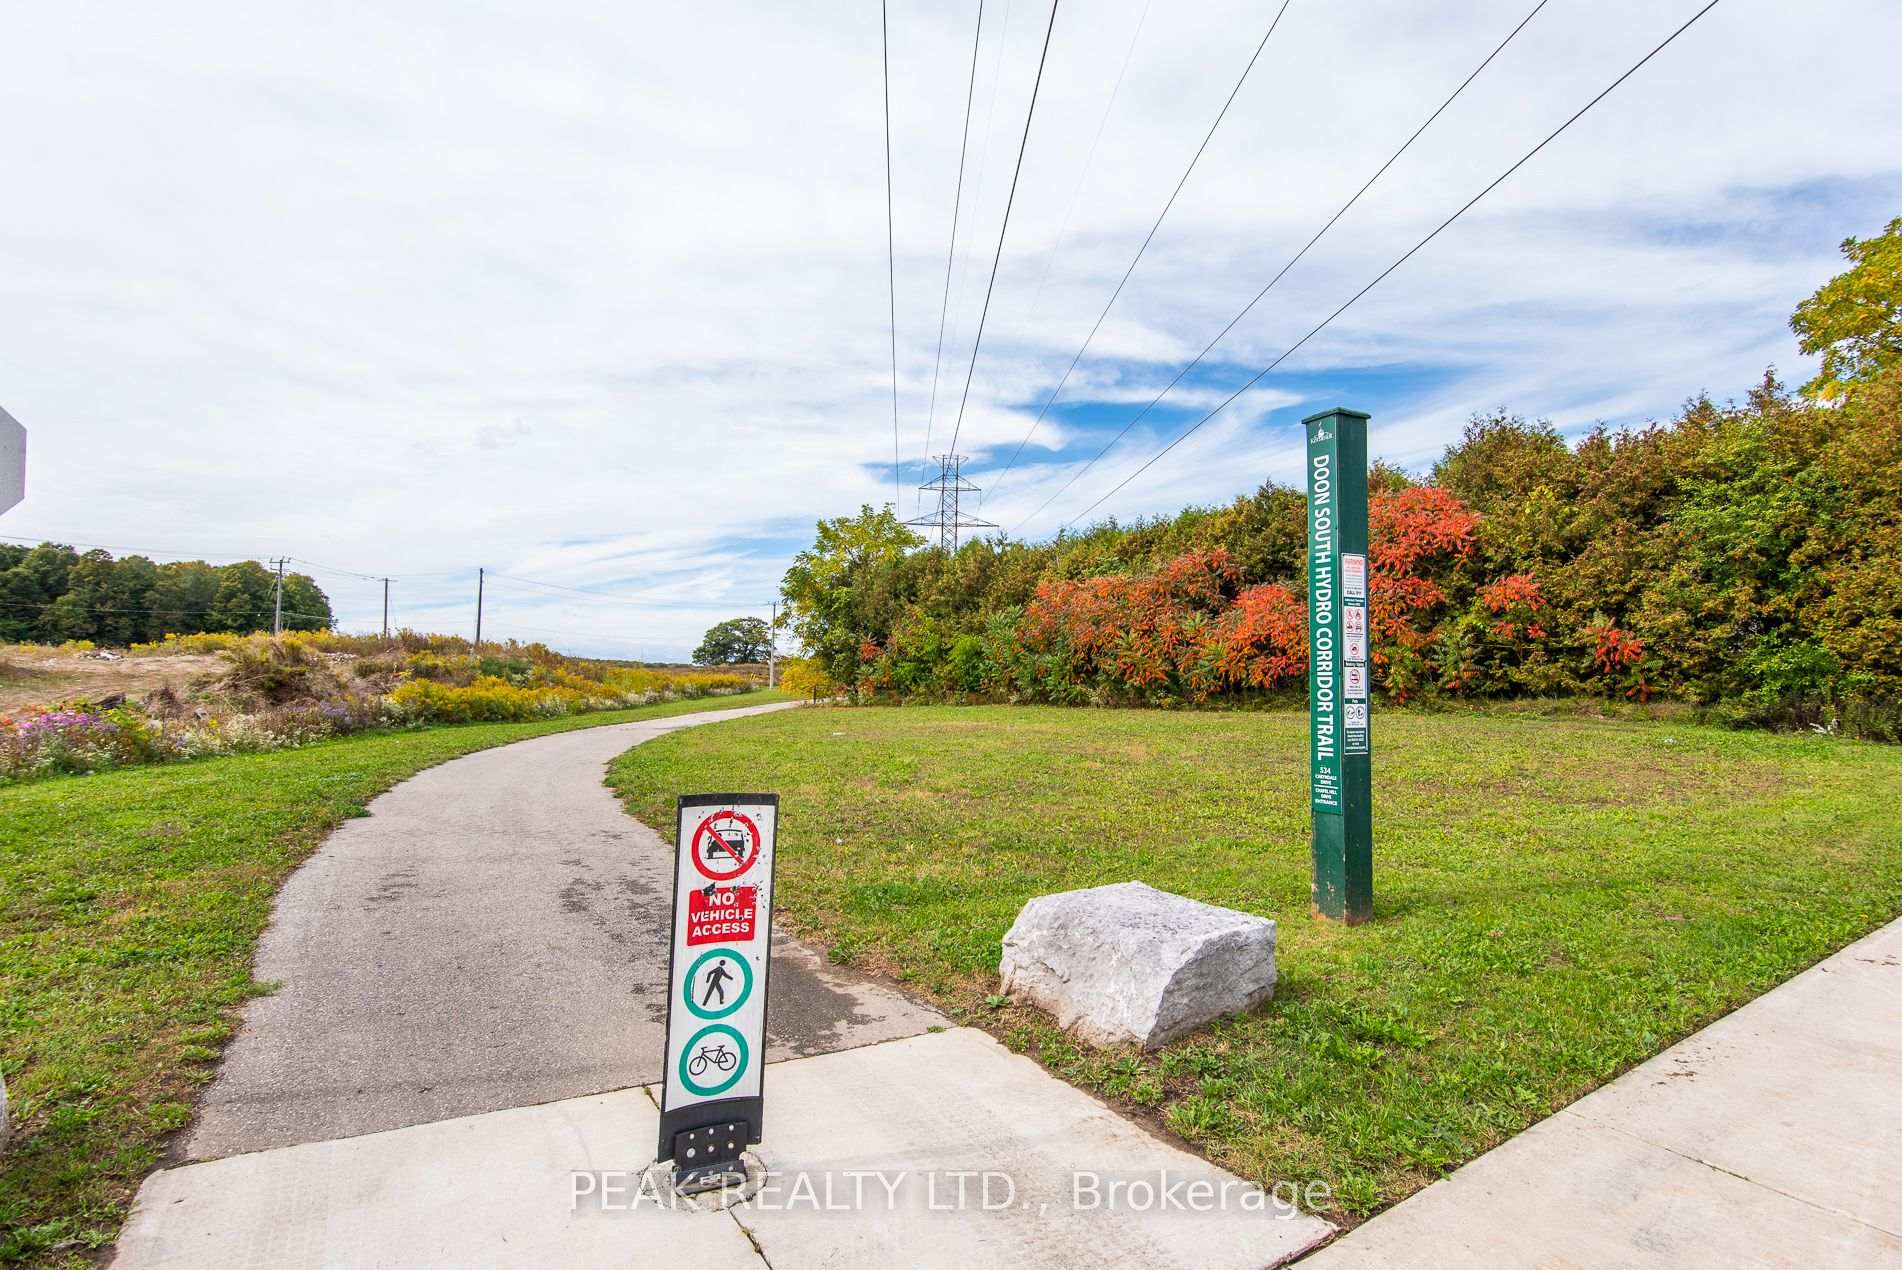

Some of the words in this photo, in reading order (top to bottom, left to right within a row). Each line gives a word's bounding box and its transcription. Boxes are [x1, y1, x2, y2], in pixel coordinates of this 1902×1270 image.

[1313, 454, 1330, 506] DOON
[1314, 509, 1331, 563] SOUTH
[1314, 567, 1332, 625] HYDRO
[1316, 627, 1334, 711] CORRIDOR
[1317, 715, 1334, 760] TRAIL
[1319, 766, 1331, 774] 534
[691, 908, 752, 922] VEHICLE
[708, 892, 734, 906] NO
[692, 922, 750, 936] ACCESS
